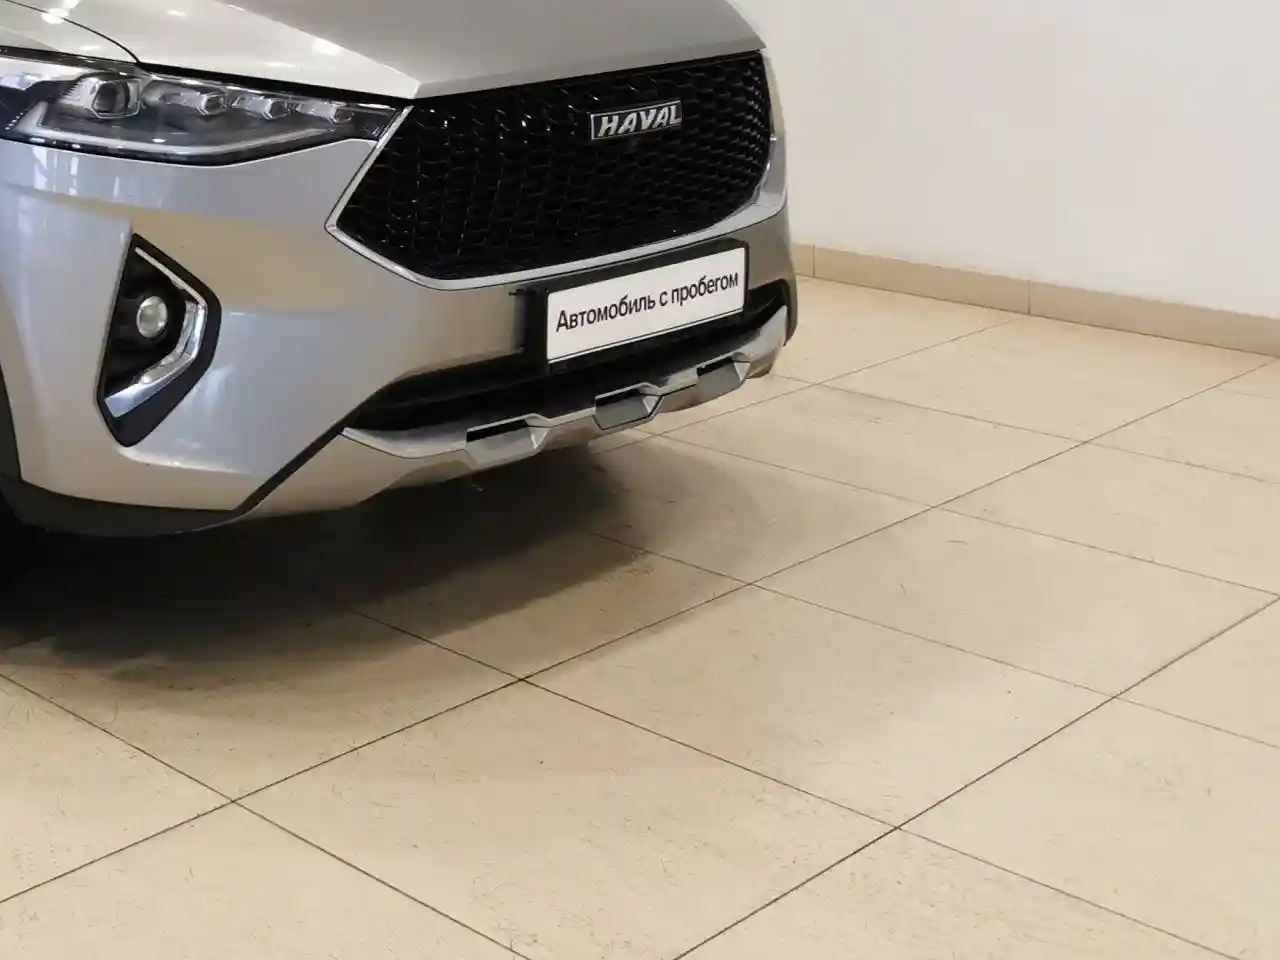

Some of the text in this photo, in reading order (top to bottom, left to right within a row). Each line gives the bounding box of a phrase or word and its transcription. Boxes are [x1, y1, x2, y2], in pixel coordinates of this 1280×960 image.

[598, 104, 682, 137] HAVAL
[555, 270, 739, 333] Автомобиль с пробегом
